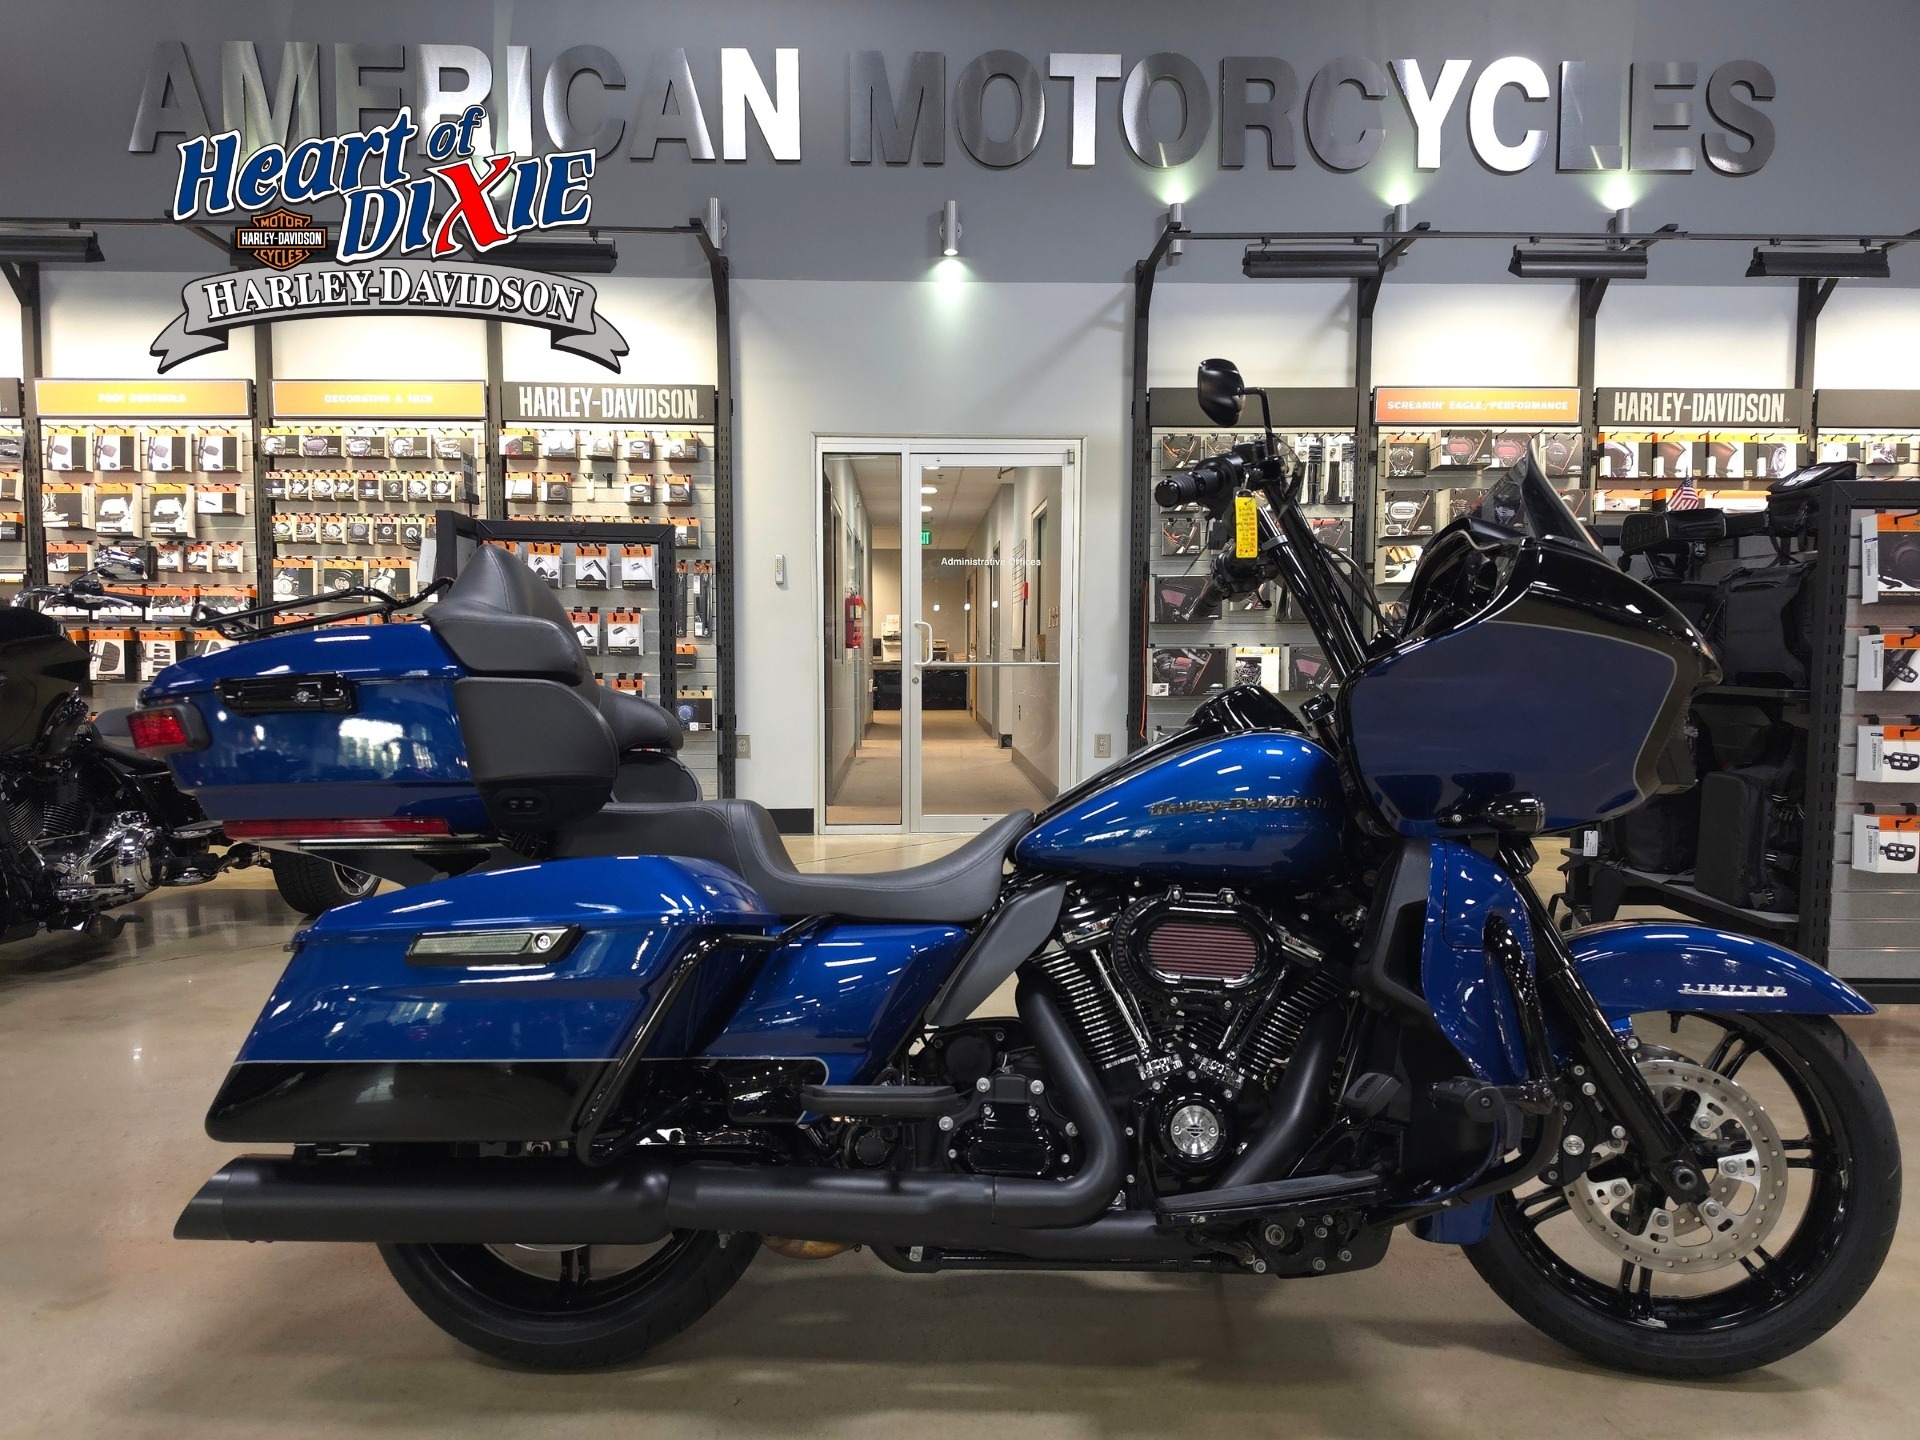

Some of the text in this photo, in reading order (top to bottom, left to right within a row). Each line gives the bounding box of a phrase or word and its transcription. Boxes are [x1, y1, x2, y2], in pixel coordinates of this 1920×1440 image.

[128, 40, 1777, 175] AMERICAN MOTORCYCLES
[98, 393, 125, 403] FOOT
[324, 393, 390, 404] DECORATIVE
[394, 394, 404, 404] &
[519, 386, 699, 420] HARLEY-DAVIDSON
[1387, 400, 1447, 411] SCREAMIN'
[1613, 391, 1786, 423] HARLEY-DAVIDSON
[941, 557, 1042, 566] Administrative Offices
[1679, 982, 1787, 997] LIMITED
